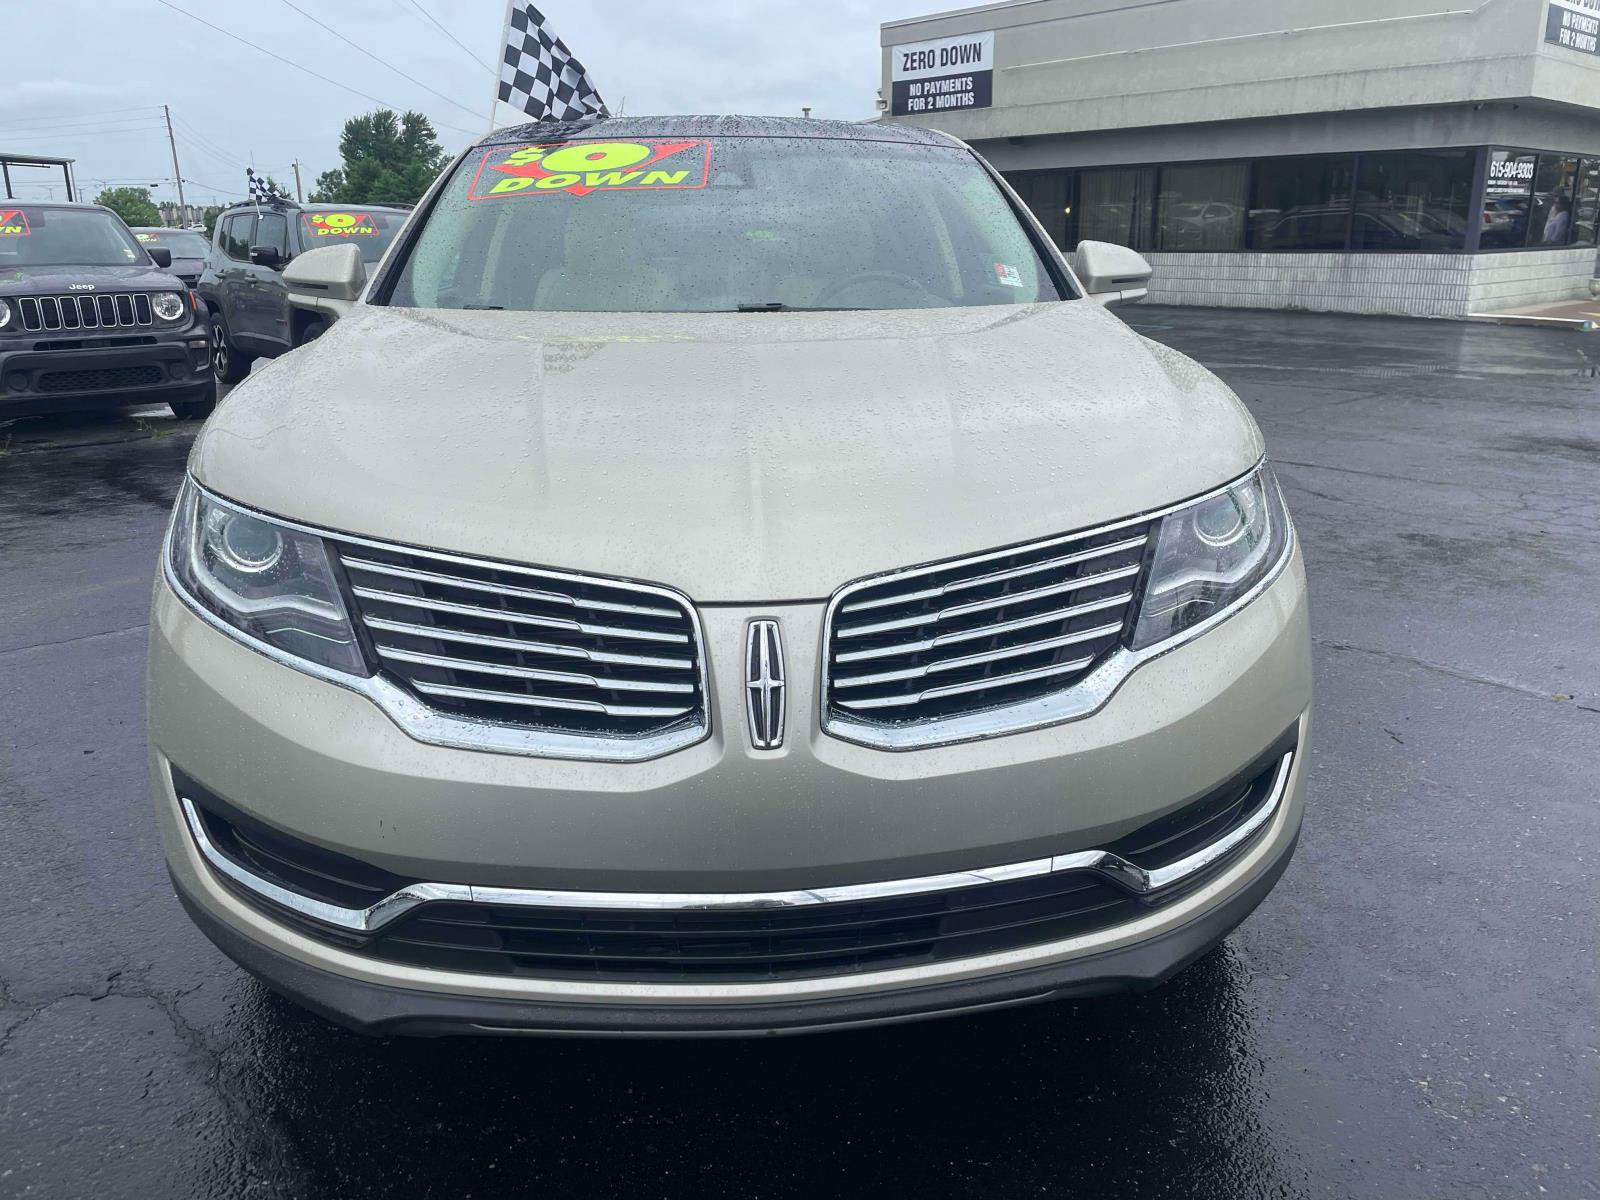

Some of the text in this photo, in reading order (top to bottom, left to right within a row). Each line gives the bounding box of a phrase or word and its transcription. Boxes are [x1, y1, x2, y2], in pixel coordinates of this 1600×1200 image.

[1570, 31, 1576, 46] 2
[902, 42, 982, 72] ZERO DOWN
[909, 77, 973, 97] NO PAYMENTS
[908, 92, 975, 112] FOR 2 MONTHS
[502, 143, 651, 172] $0
[488, 170, 690, 194] DOWN
[317, 227, 373, 236] DOWN
[69, 283, 95, 291] Jeep
